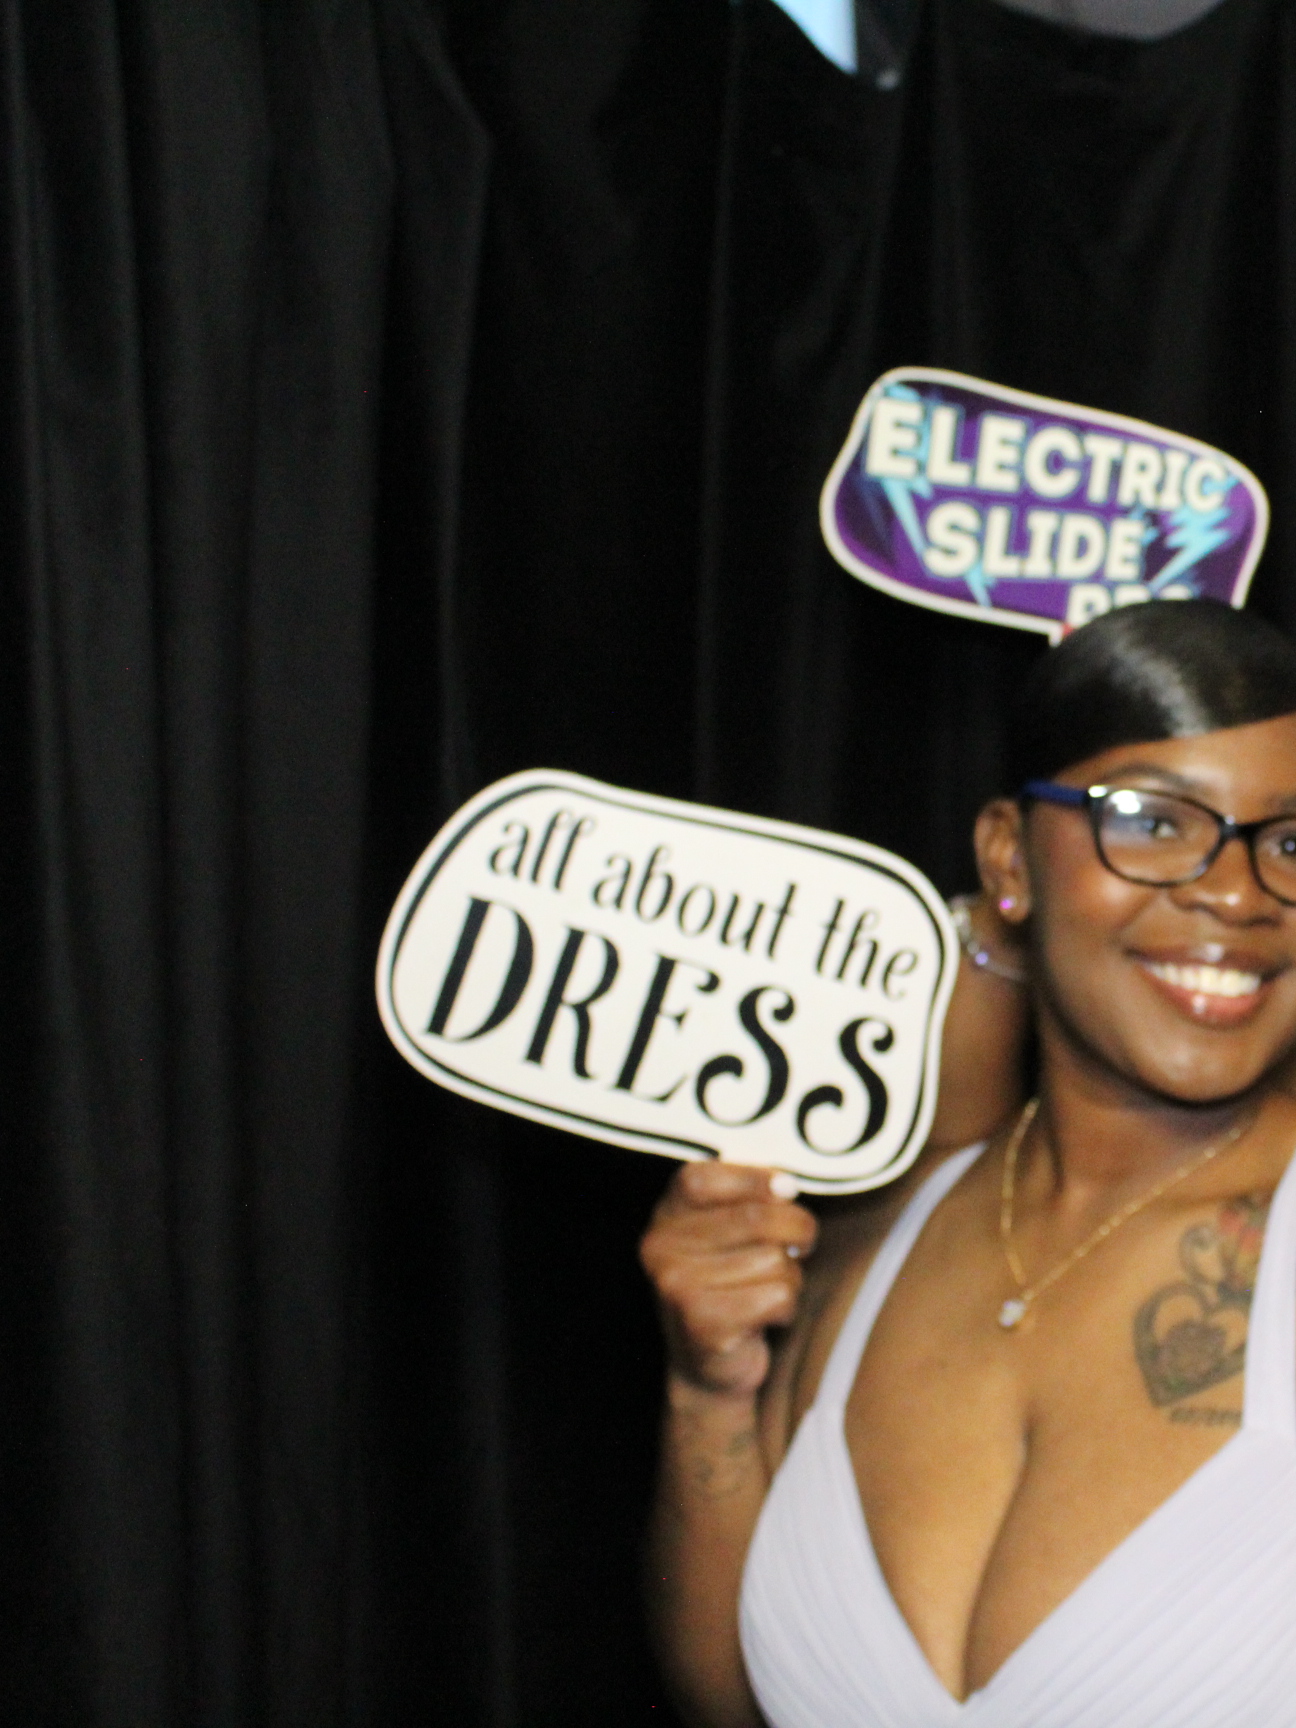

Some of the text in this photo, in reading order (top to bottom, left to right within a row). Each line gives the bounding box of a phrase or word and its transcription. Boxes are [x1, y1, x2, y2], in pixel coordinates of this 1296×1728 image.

[866, 400, 1226, 511] ELECTRIC
[924, 502, 1146, 580] SLIDE
[488, 809, 918, 1000] all about the
[424, 896, 895, 1156] DRESS
